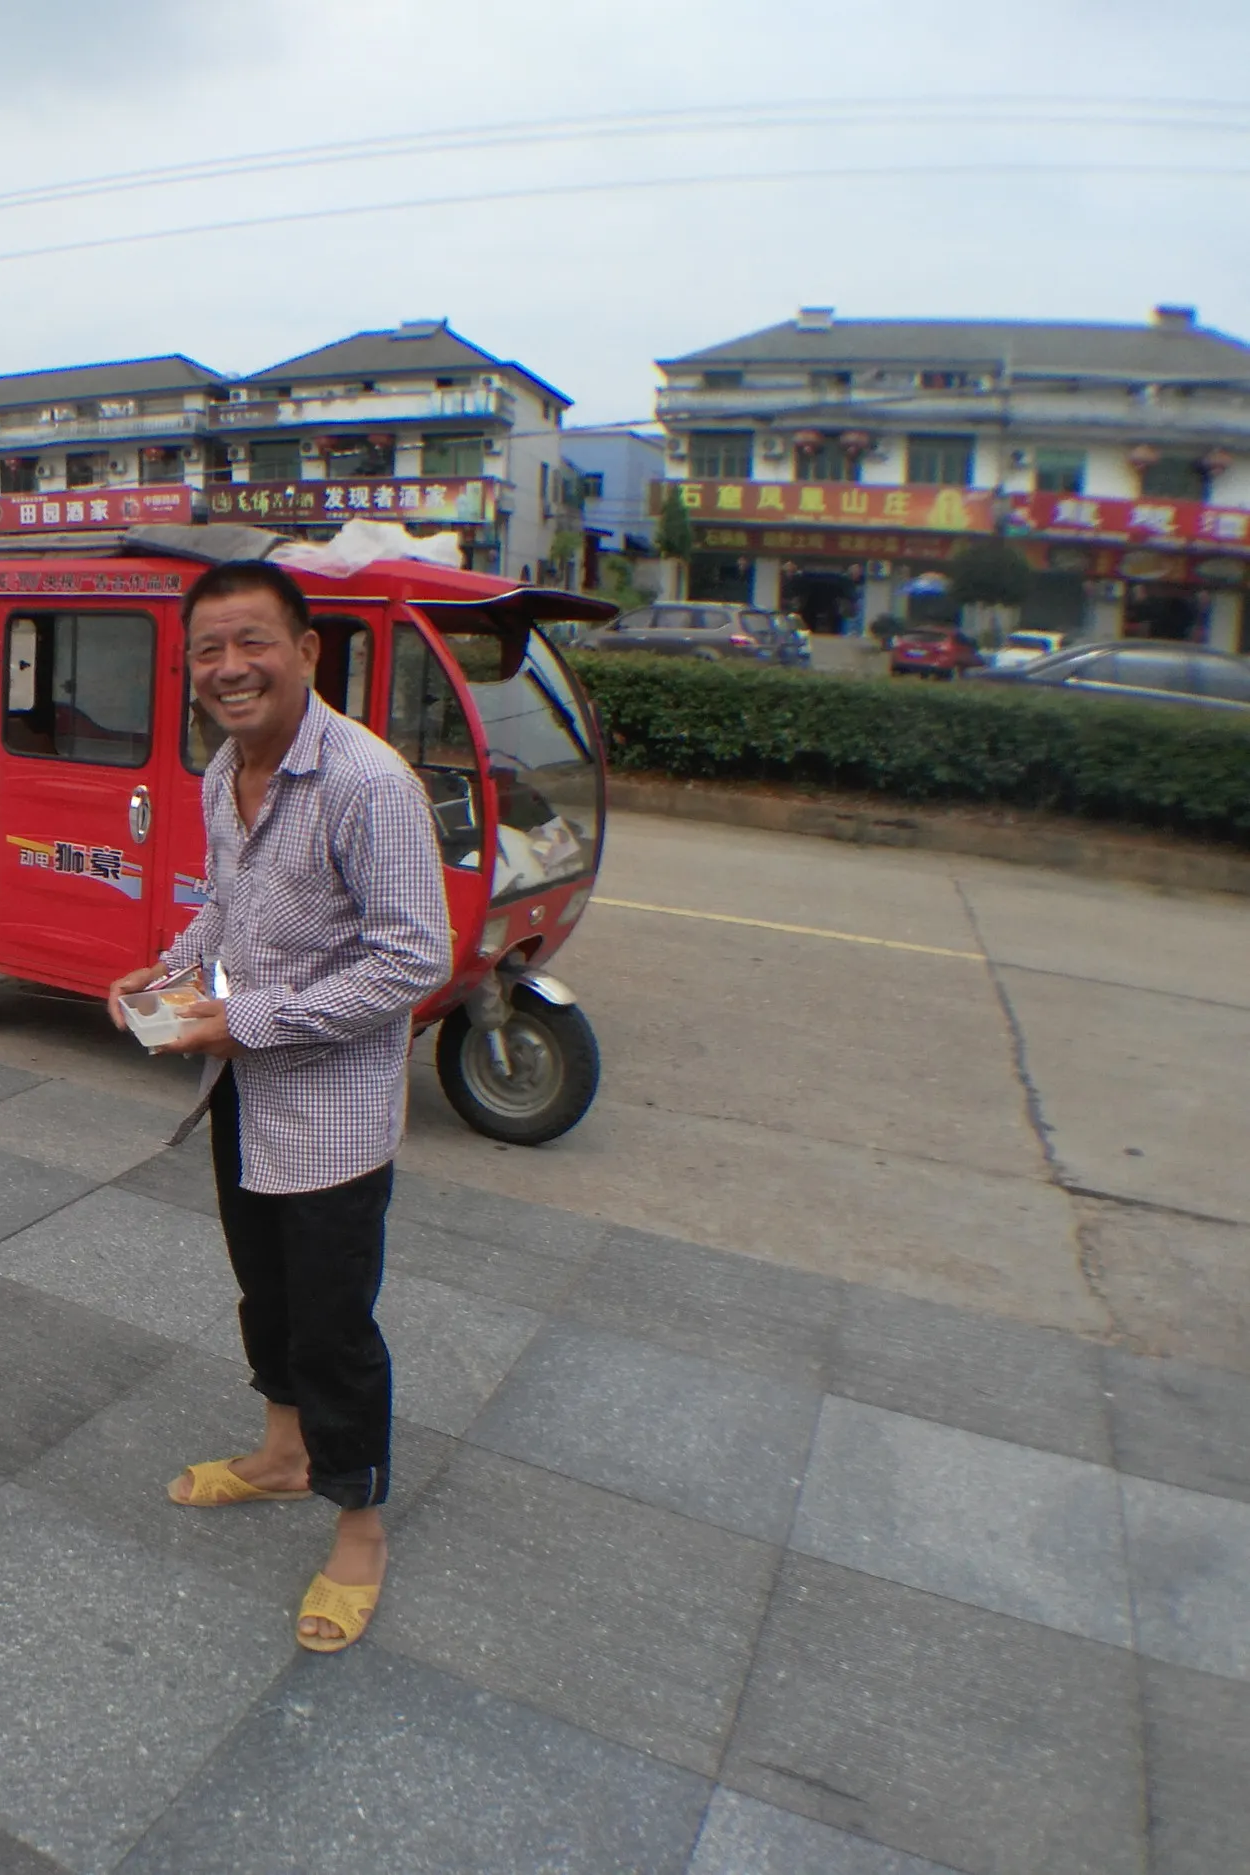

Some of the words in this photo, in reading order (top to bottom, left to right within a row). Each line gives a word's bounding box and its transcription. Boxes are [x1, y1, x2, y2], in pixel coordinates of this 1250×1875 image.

[323, 485, 447, 510] 发现者酒家
[19, 499, 109, 524] 田园酒家
